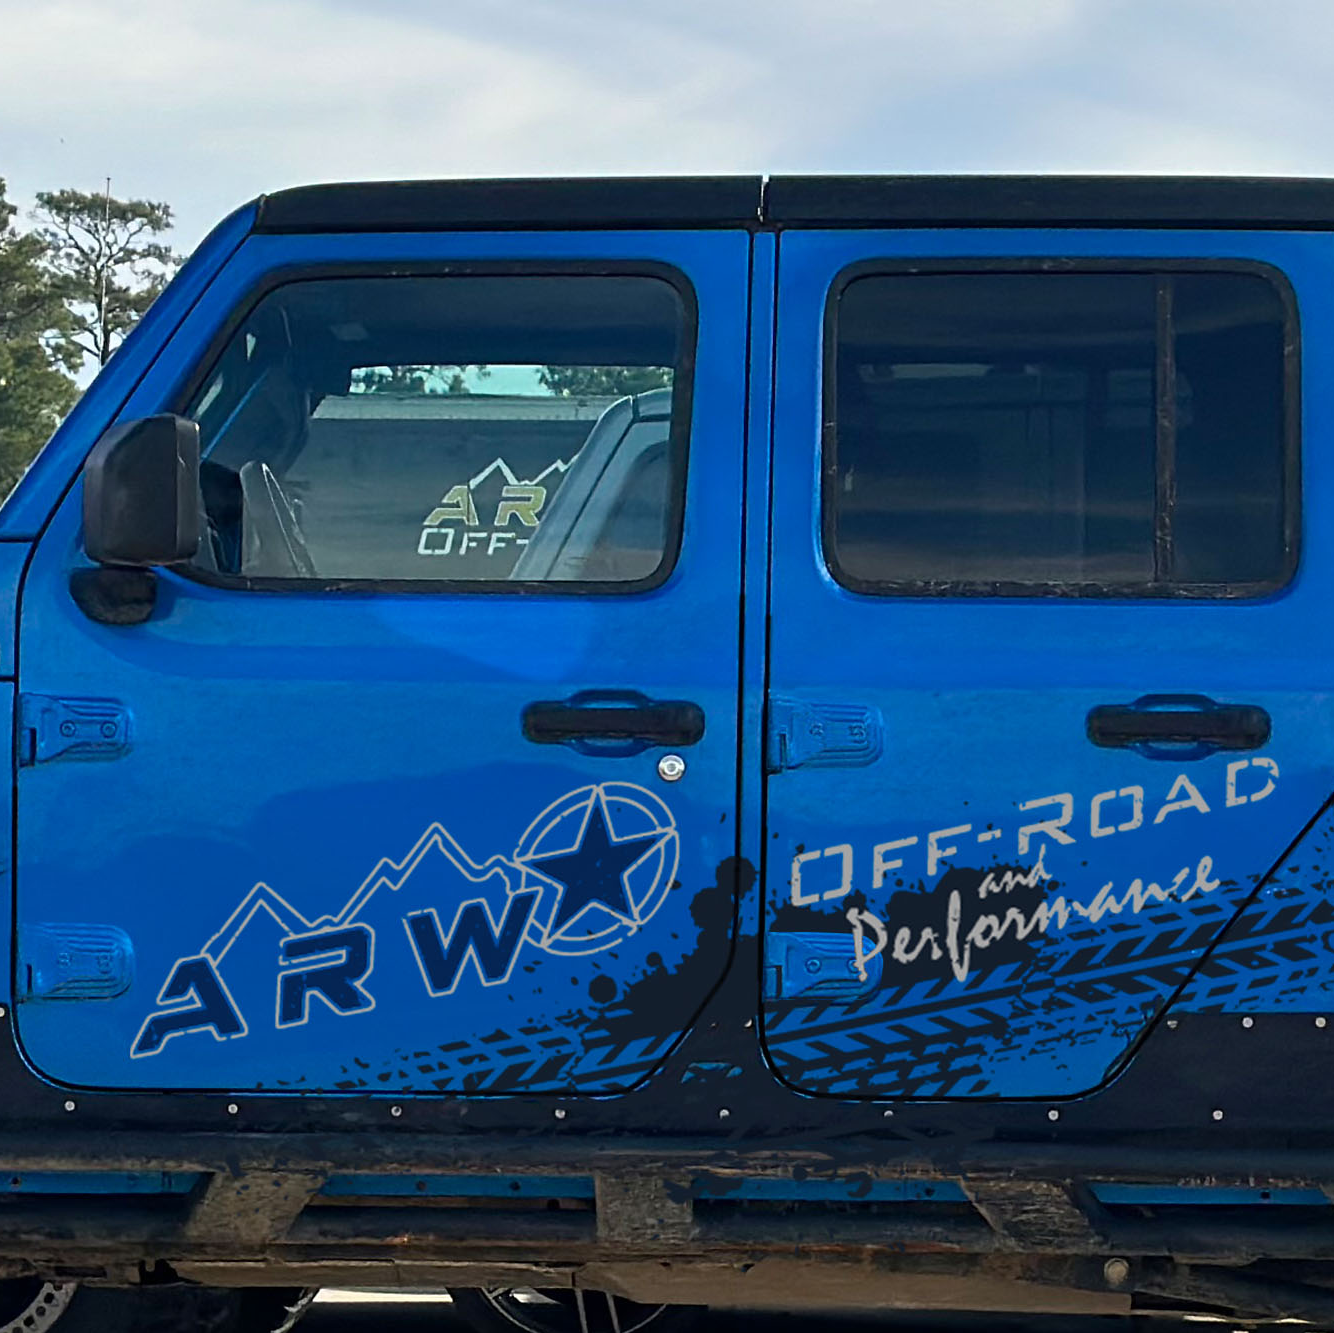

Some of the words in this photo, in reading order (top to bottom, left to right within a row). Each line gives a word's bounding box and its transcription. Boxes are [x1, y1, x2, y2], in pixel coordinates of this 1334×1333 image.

[790, 756, 1280, 907] OFF-ROAD
[977, 844, 1054, 900] and
[130, 885, 544, 1059] ARW
[846, 855, 1221, 983] Performance
